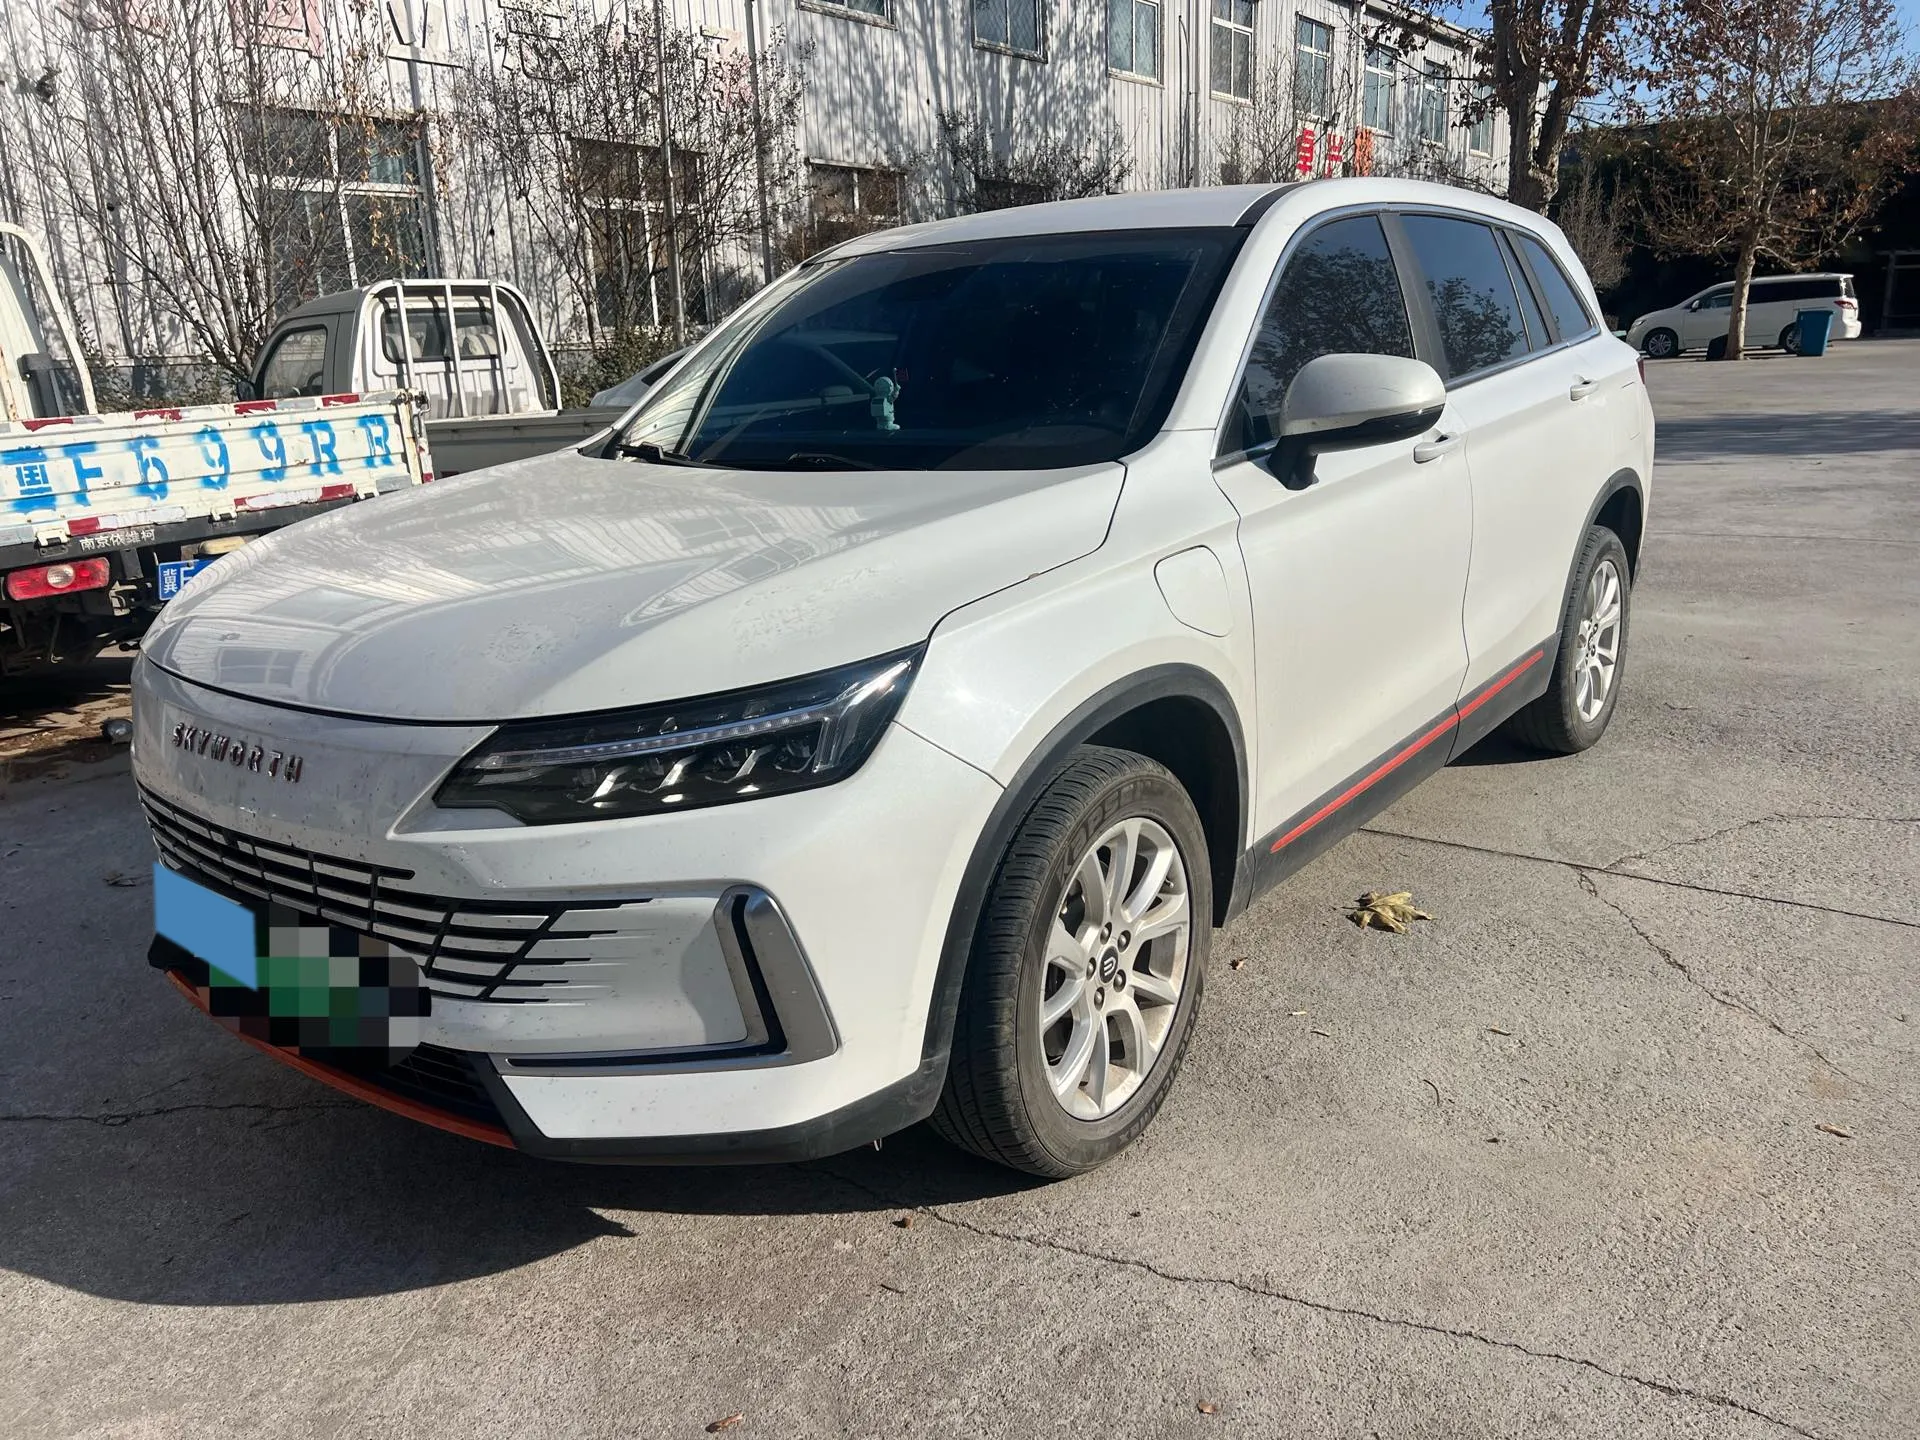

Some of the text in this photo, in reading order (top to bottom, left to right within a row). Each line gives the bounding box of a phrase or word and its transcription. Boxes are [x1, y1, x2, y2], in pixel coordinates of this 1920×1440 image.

[79, 529, 155, 552] 南京依维柯
[172, 722, 303, 783] SKYWORTH
